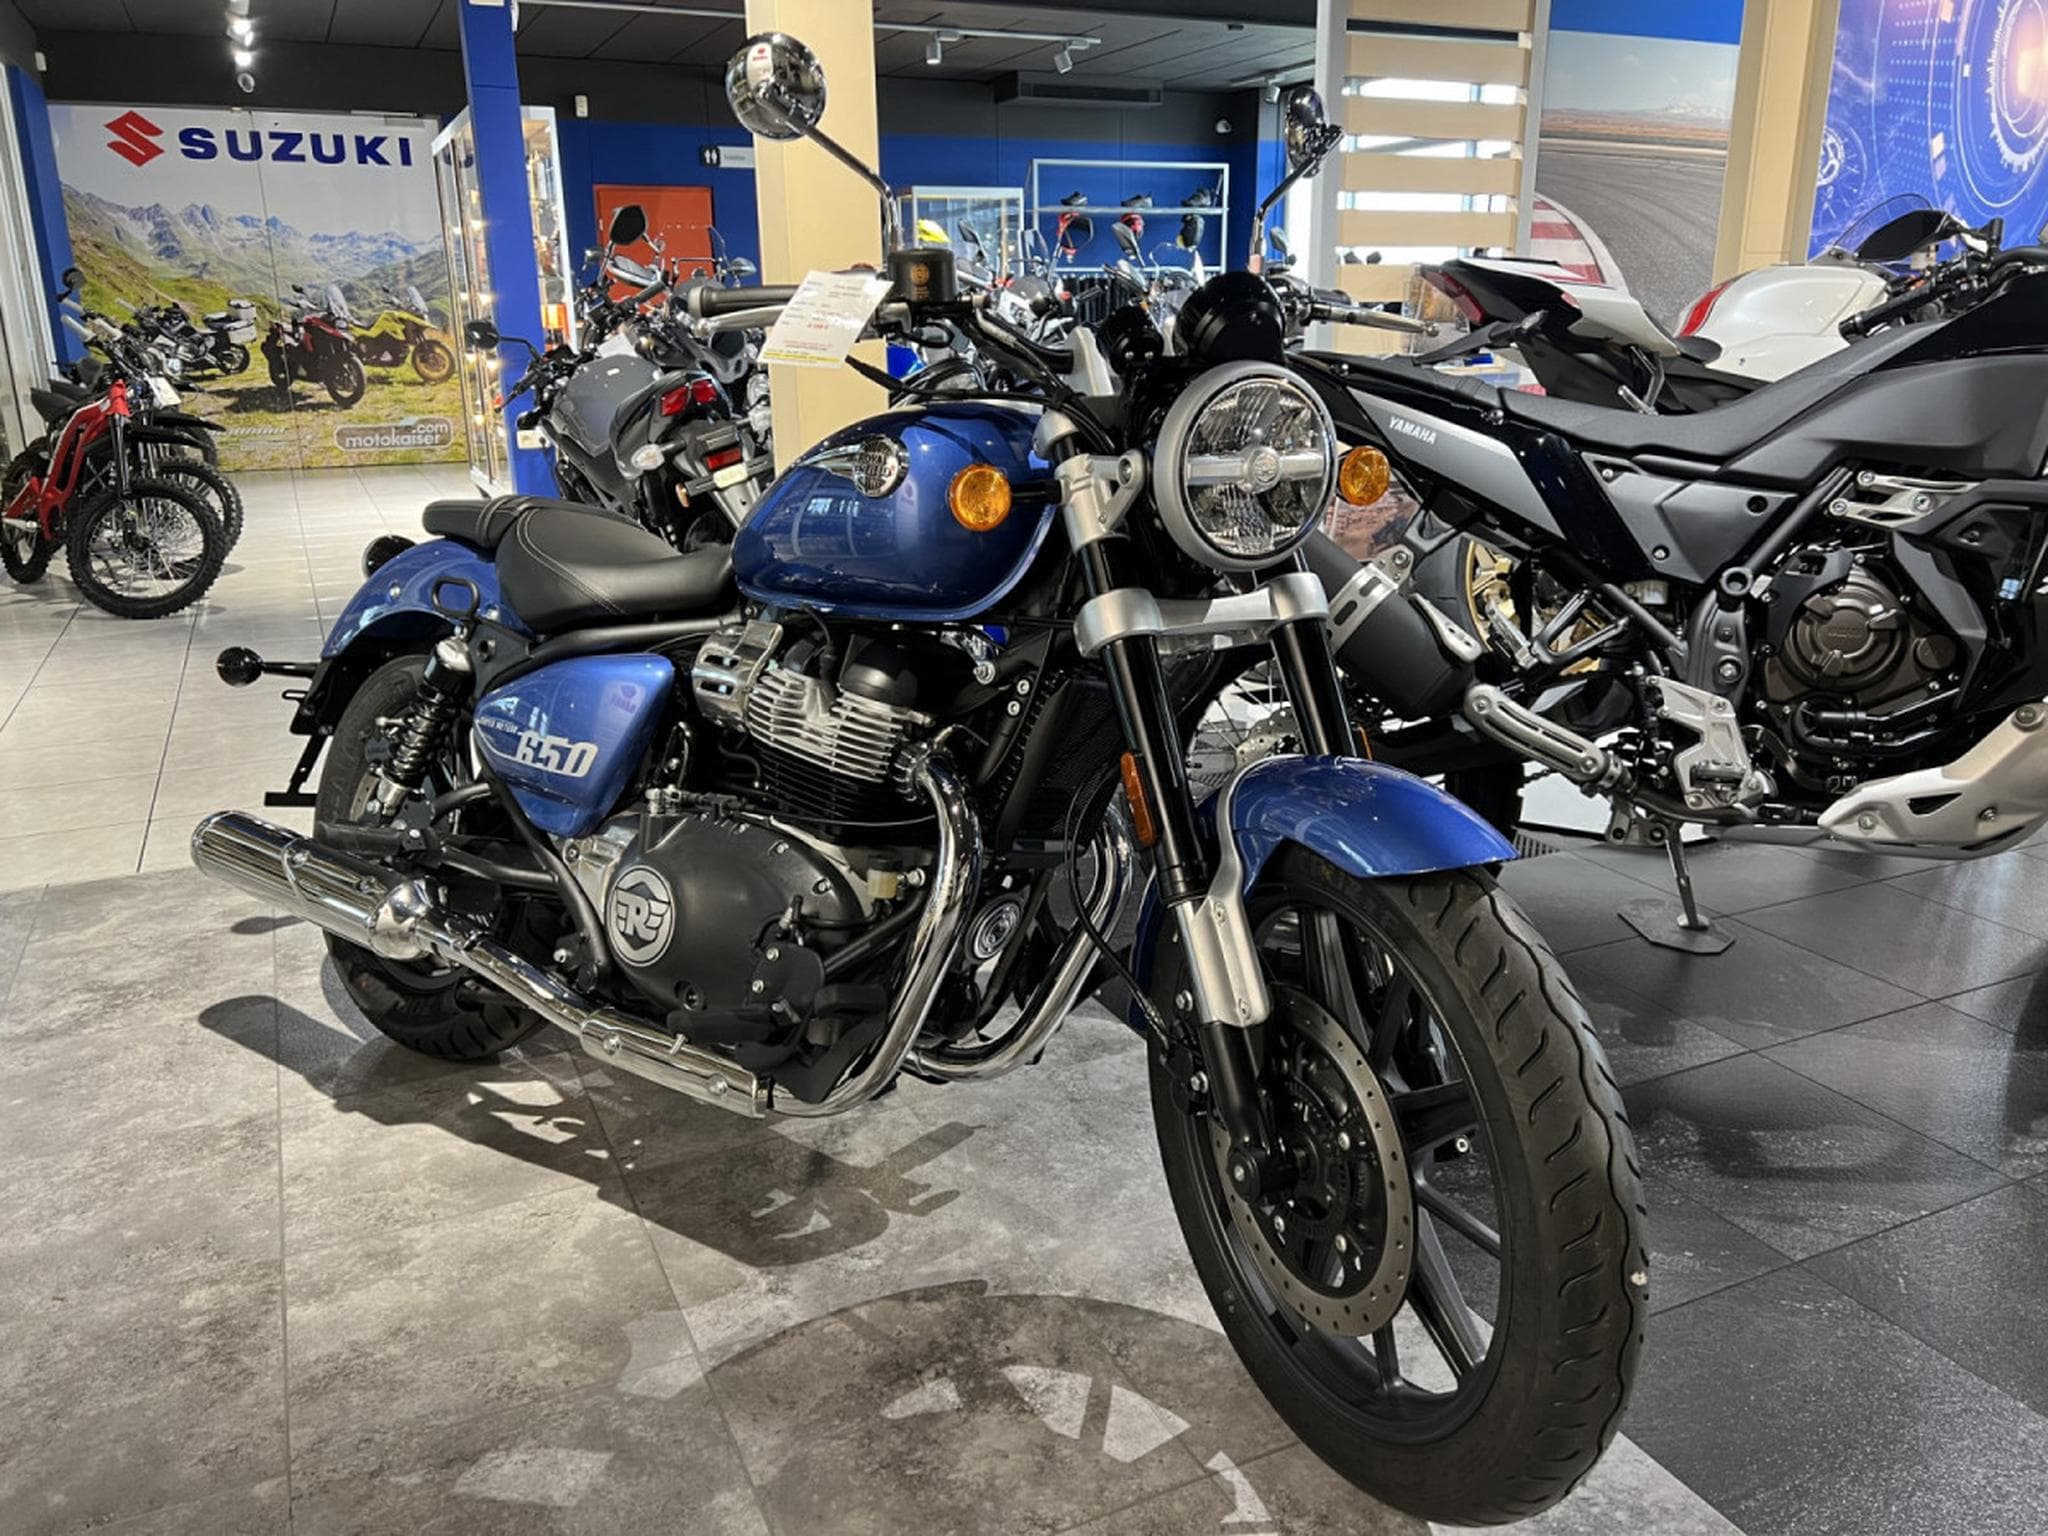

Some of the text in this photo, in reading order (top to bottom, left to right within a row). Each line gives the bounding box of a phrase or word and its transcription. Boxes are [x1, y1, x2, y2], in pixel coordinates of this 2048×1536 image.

[178, 127, 413, 167] SUZUKI
[345, 427, 441, 449] motokaiser
[1389, 416, 1437, 445] YAMAHA
[515, 730, 599, 778] 650
